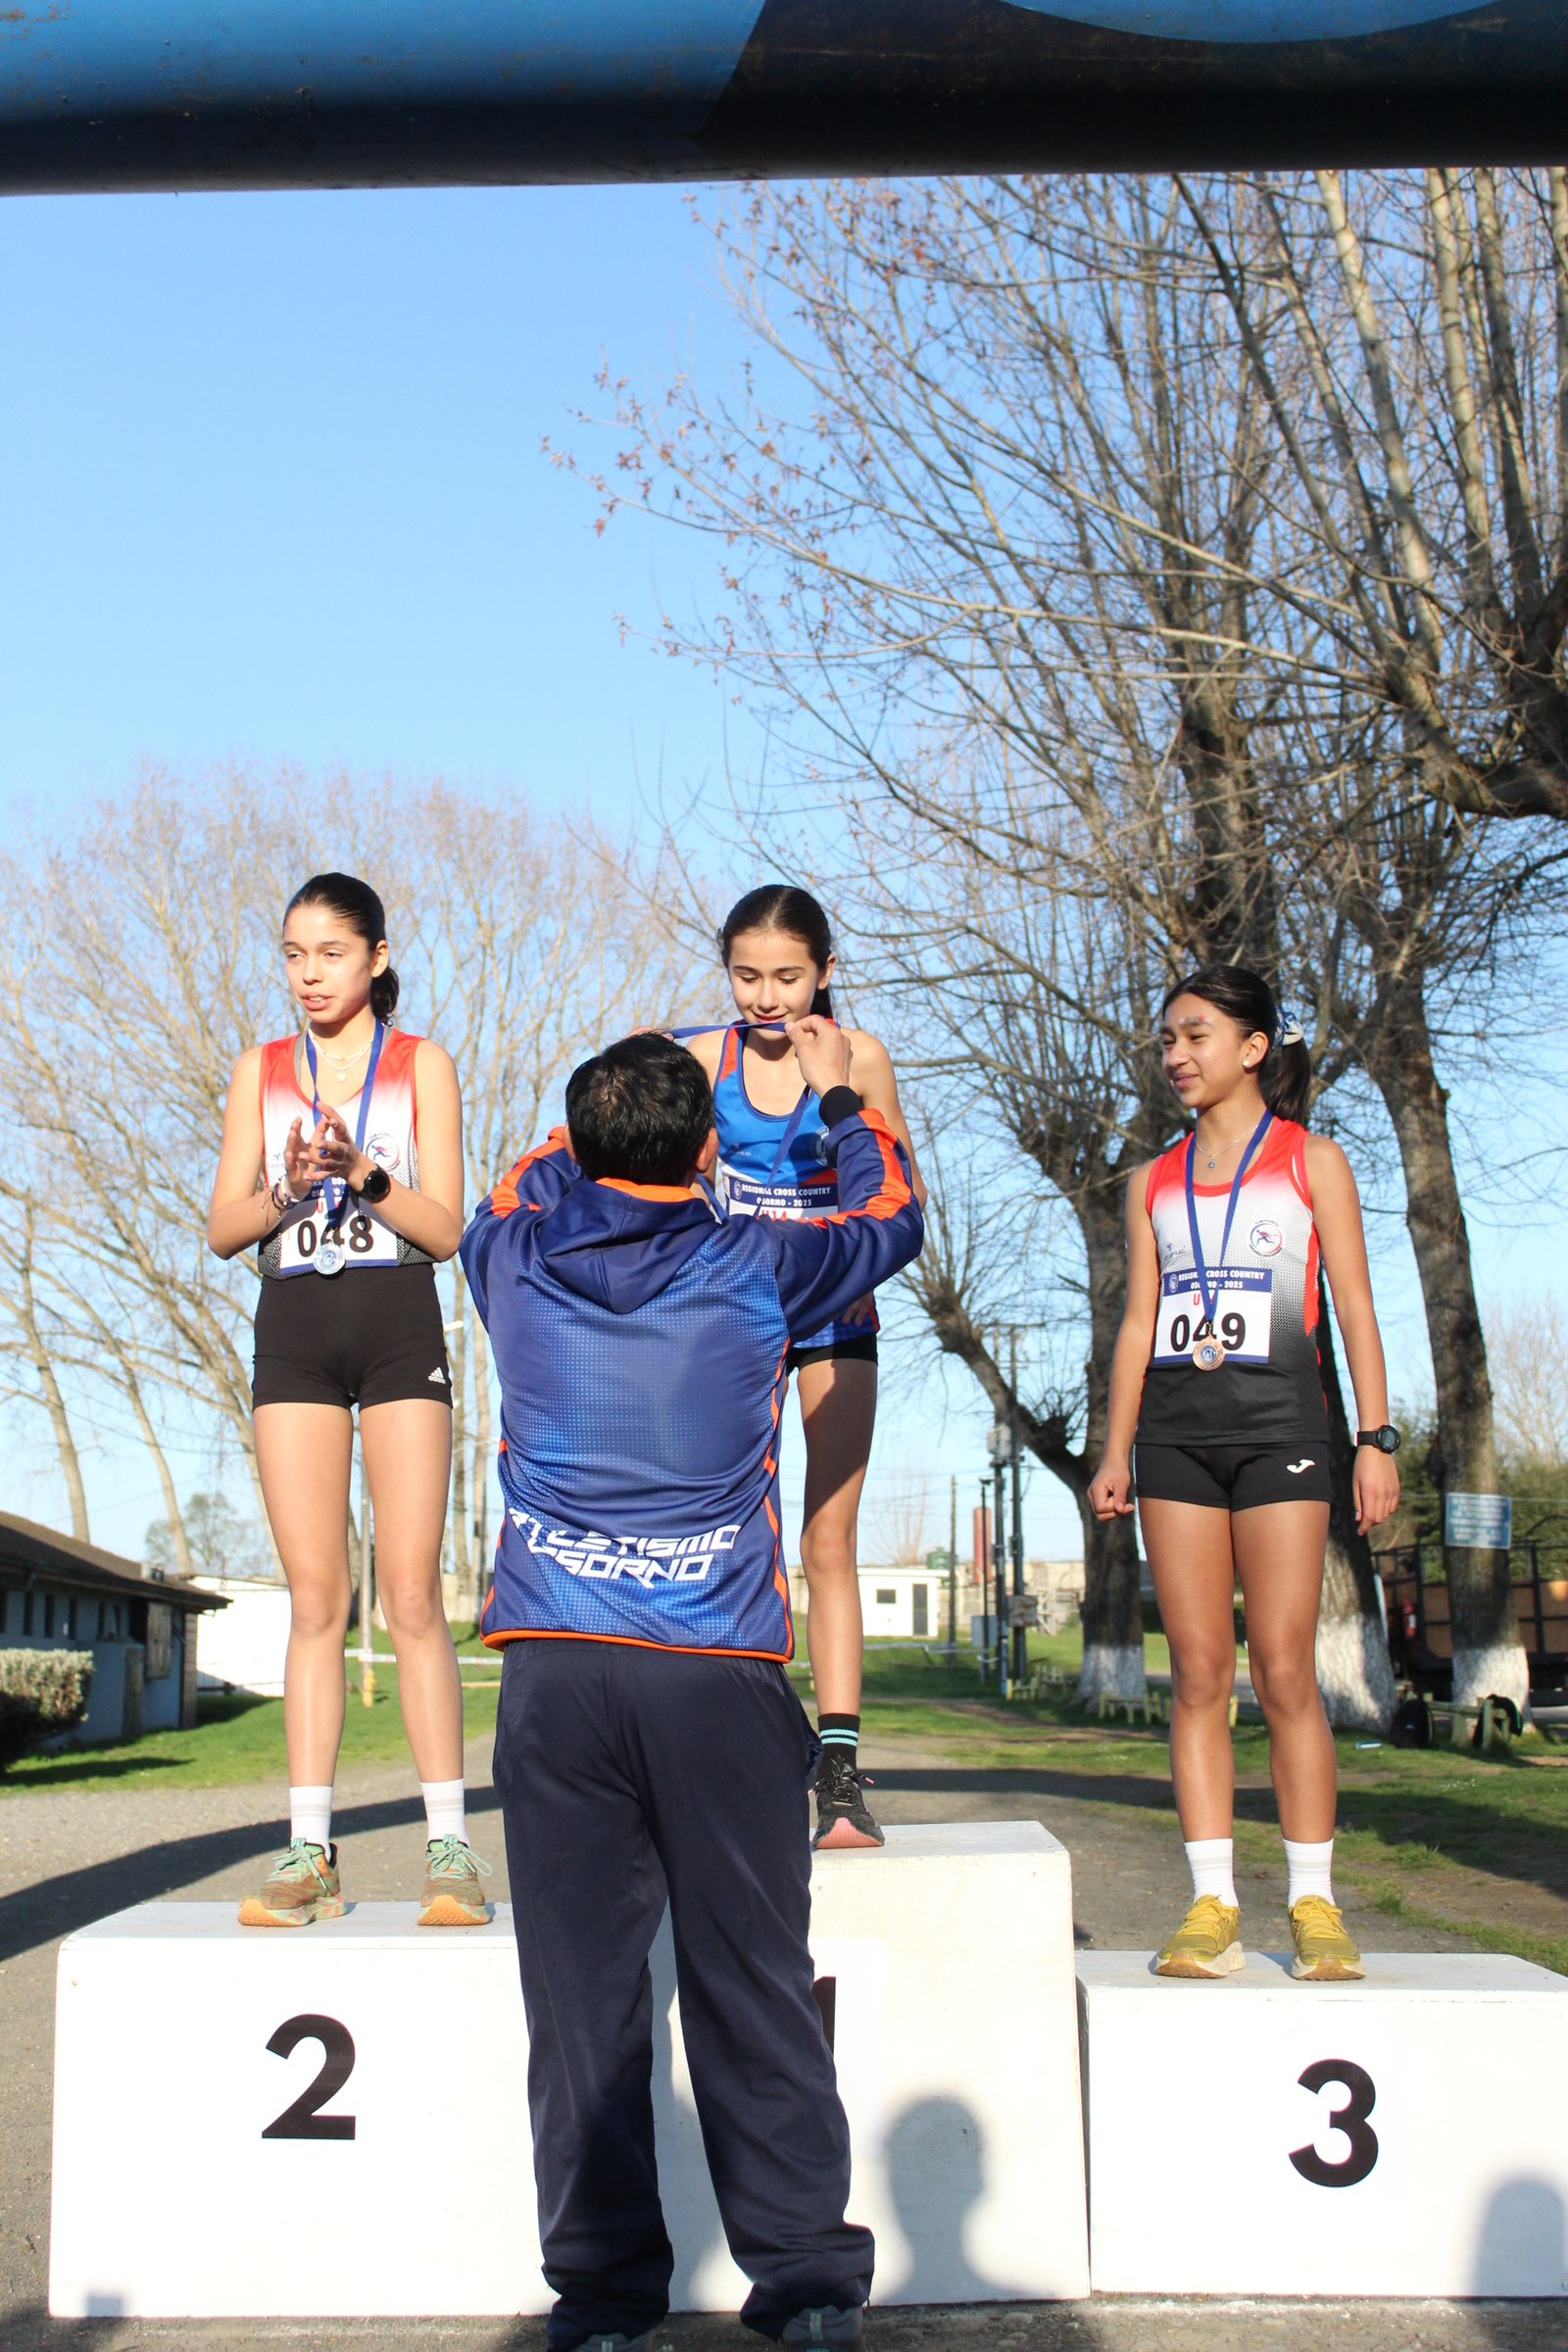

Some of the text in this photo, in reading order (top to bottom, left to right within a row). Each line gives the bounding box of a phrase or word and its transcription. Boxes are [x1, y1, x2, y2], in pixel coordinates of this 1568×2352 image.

[312, 1188, 340, 1198] OSOO
[742, 1184, 772, 1195] REGIONAL
[798, 1187, 831, 1196] COUNTRY
[757, 1198, 786, 1206] OSORNO
[297, 1215, 373, 1257] 048
[1178, 1271, 1199, 1281] REGION
[1230, 1270, 1265, 1279] COUNTRY
[1191, 1281, 1217, 1290] OSNO
[1170, 1312, 1247, 1352] 049
[262, 2013, 356, 2140] 2
[1288, 2058, 1379, 2187] 3
